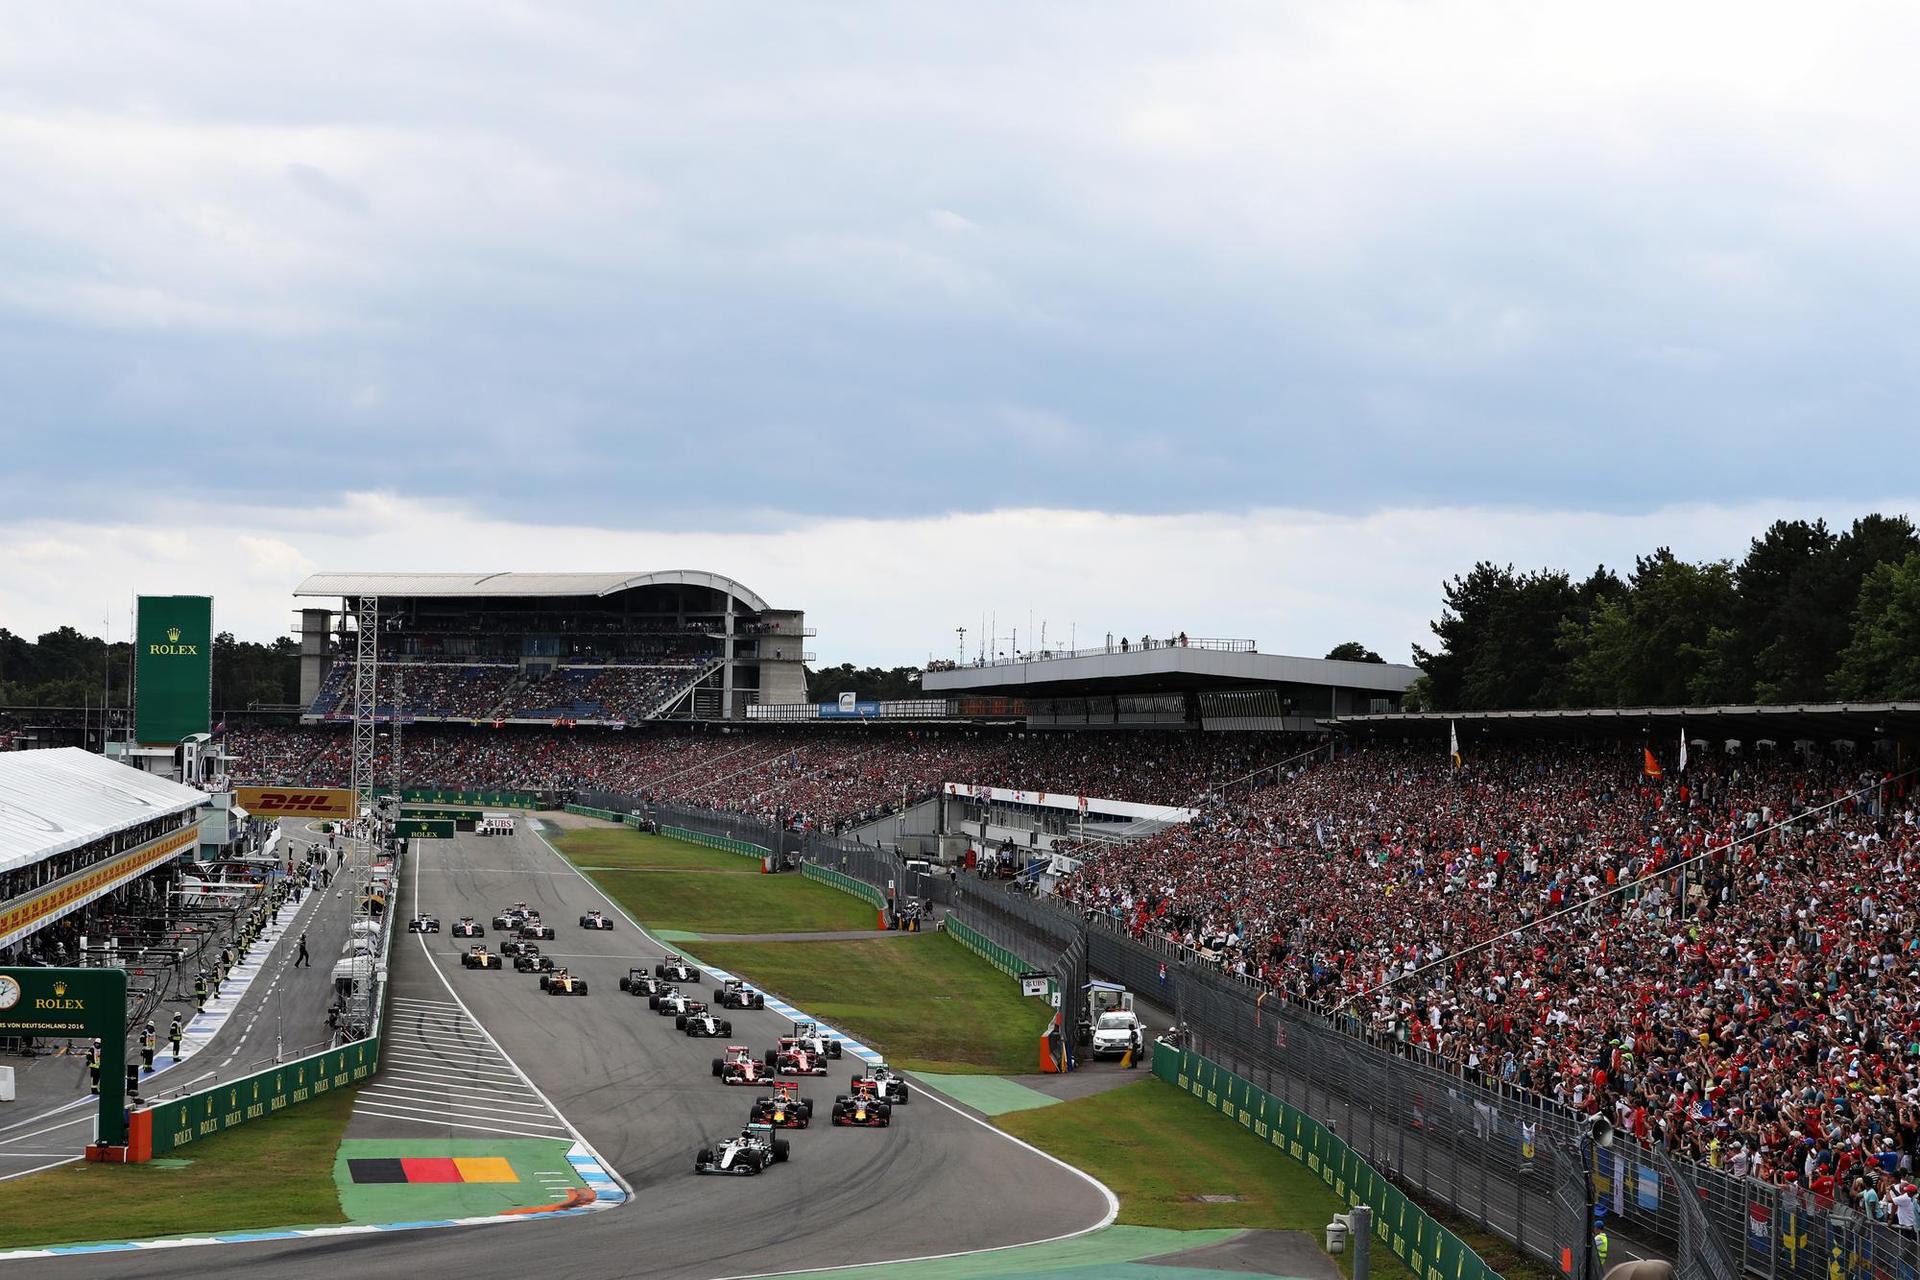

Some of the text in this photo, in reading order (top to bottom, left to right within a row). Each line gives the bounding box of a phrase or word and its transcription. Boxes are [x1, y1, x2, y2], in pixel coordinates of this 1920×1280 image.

[149, 644, 198, 655] ROLEX
[258, 793, 333, 811] DHL
[494, 820, 512, 828] UBS
[35, 999, 85, 1009] ROLEX
[1054, 995, 1059, 1004] 2
[21, 1022, 67, 1030] DEUTSCHLAND
[174, 1128, 193, 1147] ROLEX
[200, 1117, 218, 1135] ROLEX
[225, 1110, 242, 1128] ROLEX
[247, 1102, 264, 1119] ROLEX
[271, 1095, 287, 1111] ROLEX
[293, 1087, 309, 1103] ROLEX
